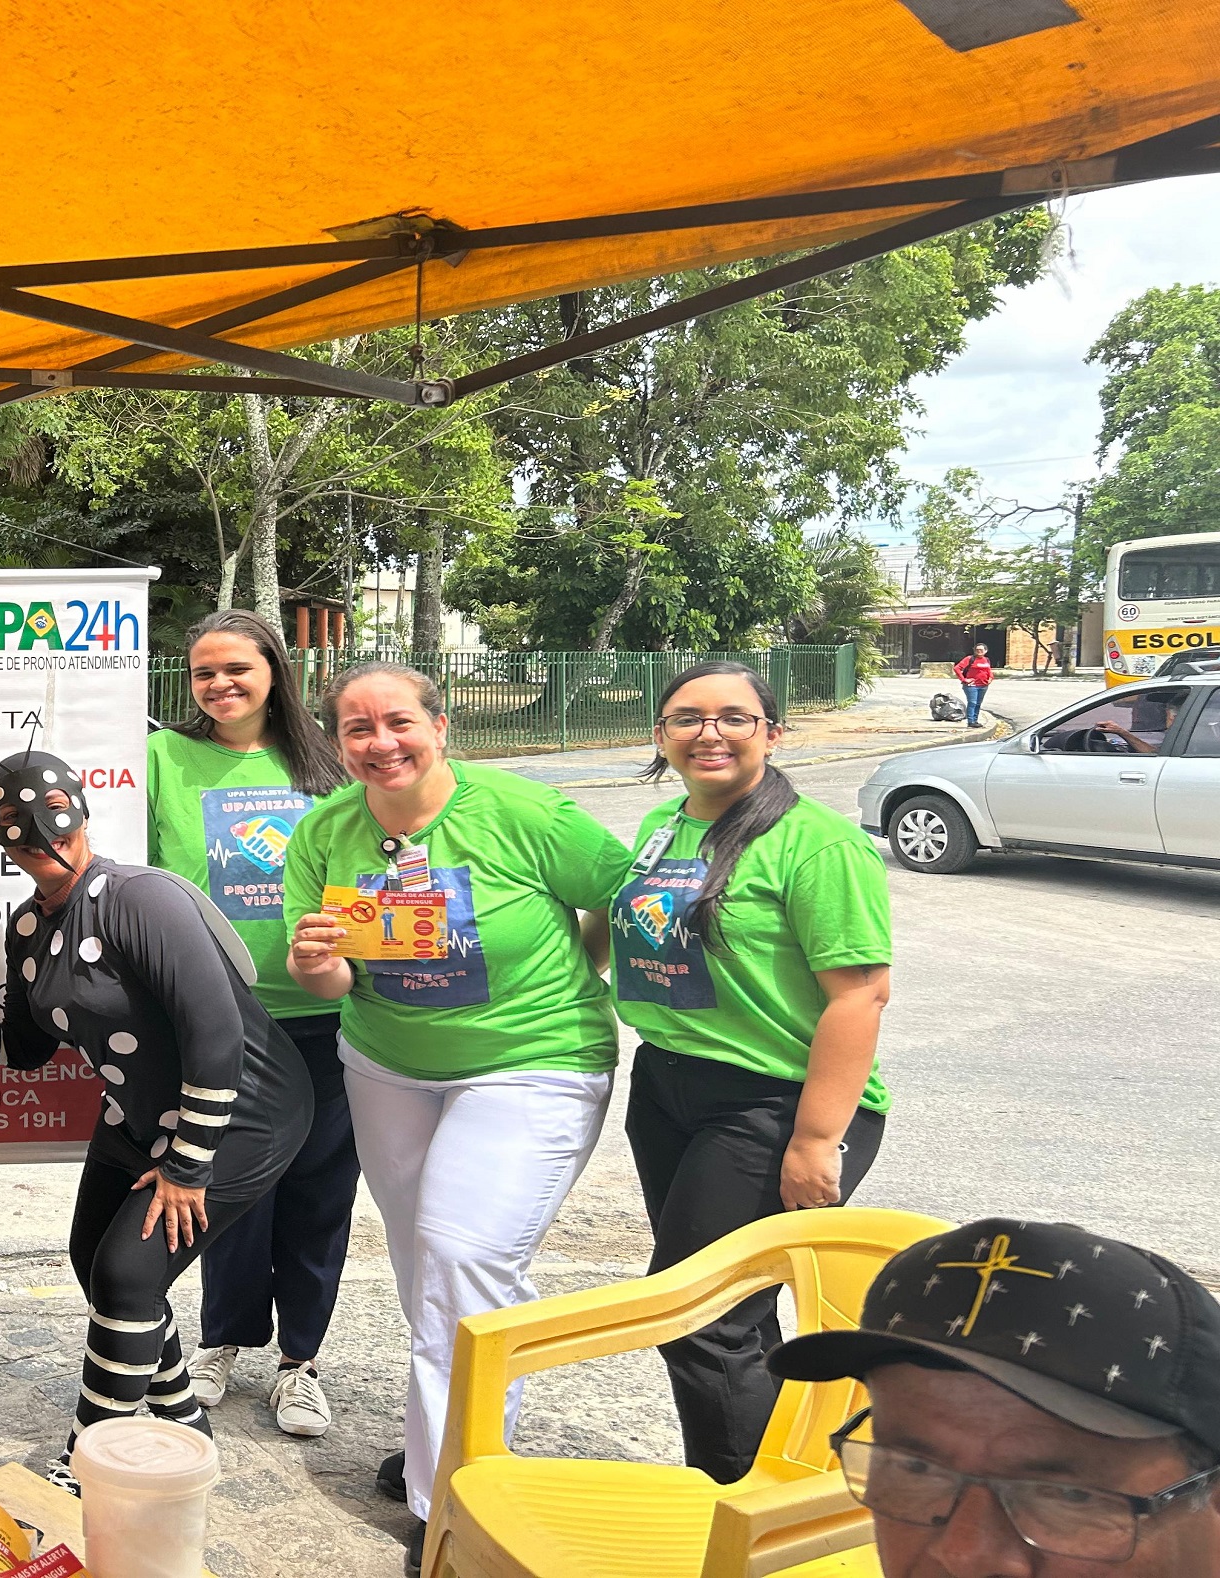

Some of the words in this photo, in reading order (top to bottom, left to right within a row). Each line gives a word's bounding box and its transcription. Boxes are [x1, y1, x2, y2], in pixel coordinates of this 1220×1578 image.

[1121, 607, 1137, 615] 60
[1132, 632, 1220, 649] ESCOL
[6, 656, 21, 670] DE
[23, 655, 67, 670] PRONTO
[68, 655, 141, 670] ATENDIMENTO
[222, 799, 306, 813] UPANIZAR
[223, 883, 285, 896] PROTEG
[242, 895, 284, 906] VIDA
[18, 1111, 66, 1128] 19H
[10, 1568, 31, 1578] NAIS
[28, 1562, 42, 1574] DE
[40, 1547, 69, 1568] ALERTA
[41, 1565, 67, 1578] NGUE
